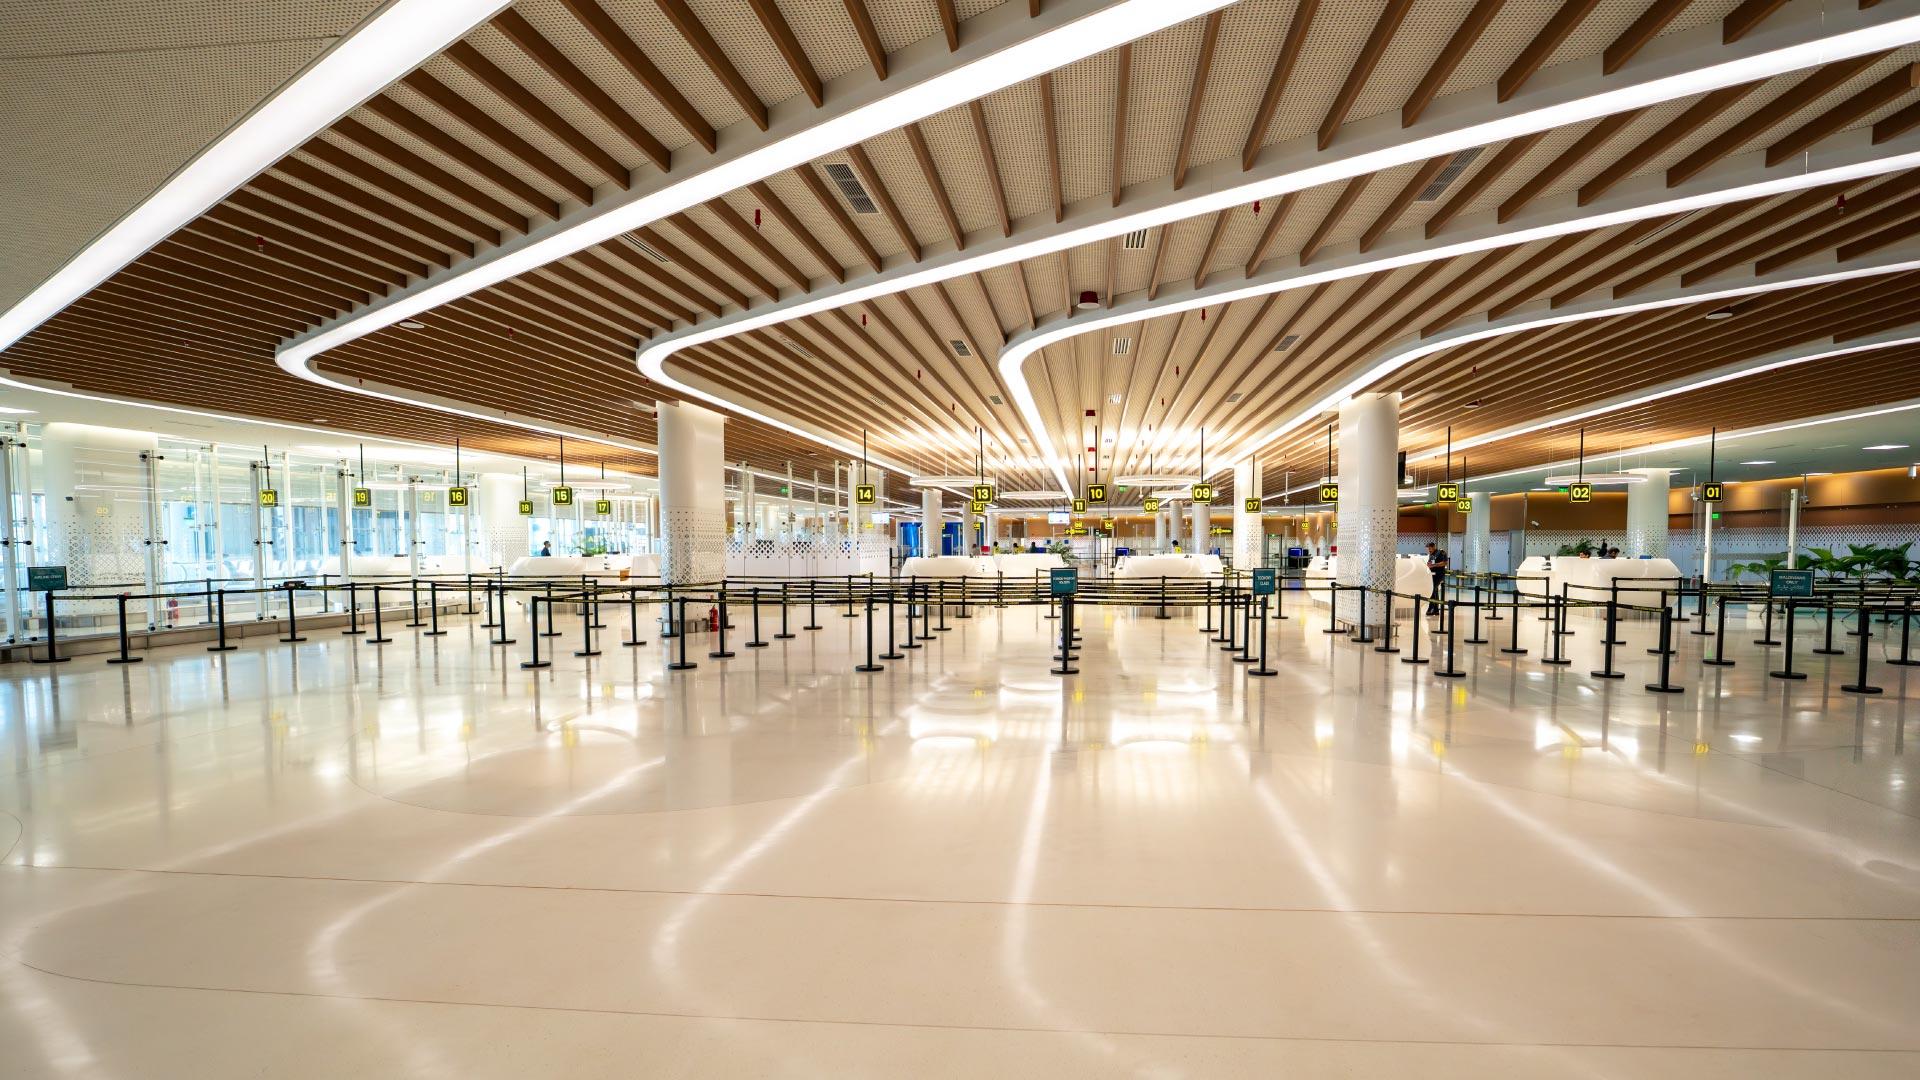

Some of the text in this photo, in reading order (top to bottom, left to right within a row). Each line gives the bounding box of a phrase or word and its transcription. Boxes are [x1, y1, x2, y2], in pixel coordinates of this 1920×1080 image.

[451, 492, 462, 501] 16
[556, 491, 567, 501] 15
[859, 489, 871, 500] 14
[976, 488, 988, 499] 13
[1090, 488, 1103, 499] 10
[1195, 487, 1209, 499] 09
[1322, 487, 1337, 499] 06
[1440, 487, 1456, 499] 05
[1573, 487, 1589, 499] 02
[1706, 487, 1719, 498] 01
[262, 494, 273, 503] 20
[357, 494, 366, 502] 19
[521, 504, 529, 512] 18
[598, 503, 606, 511] 17
[973, 503, 982, 511] 12
[1075, 502, 1083, 511] 11
[1145, 502, 1157, 511] 08
[1247, 501, 1259, 510] 07
[1458, 501, 1470, 510] 03
